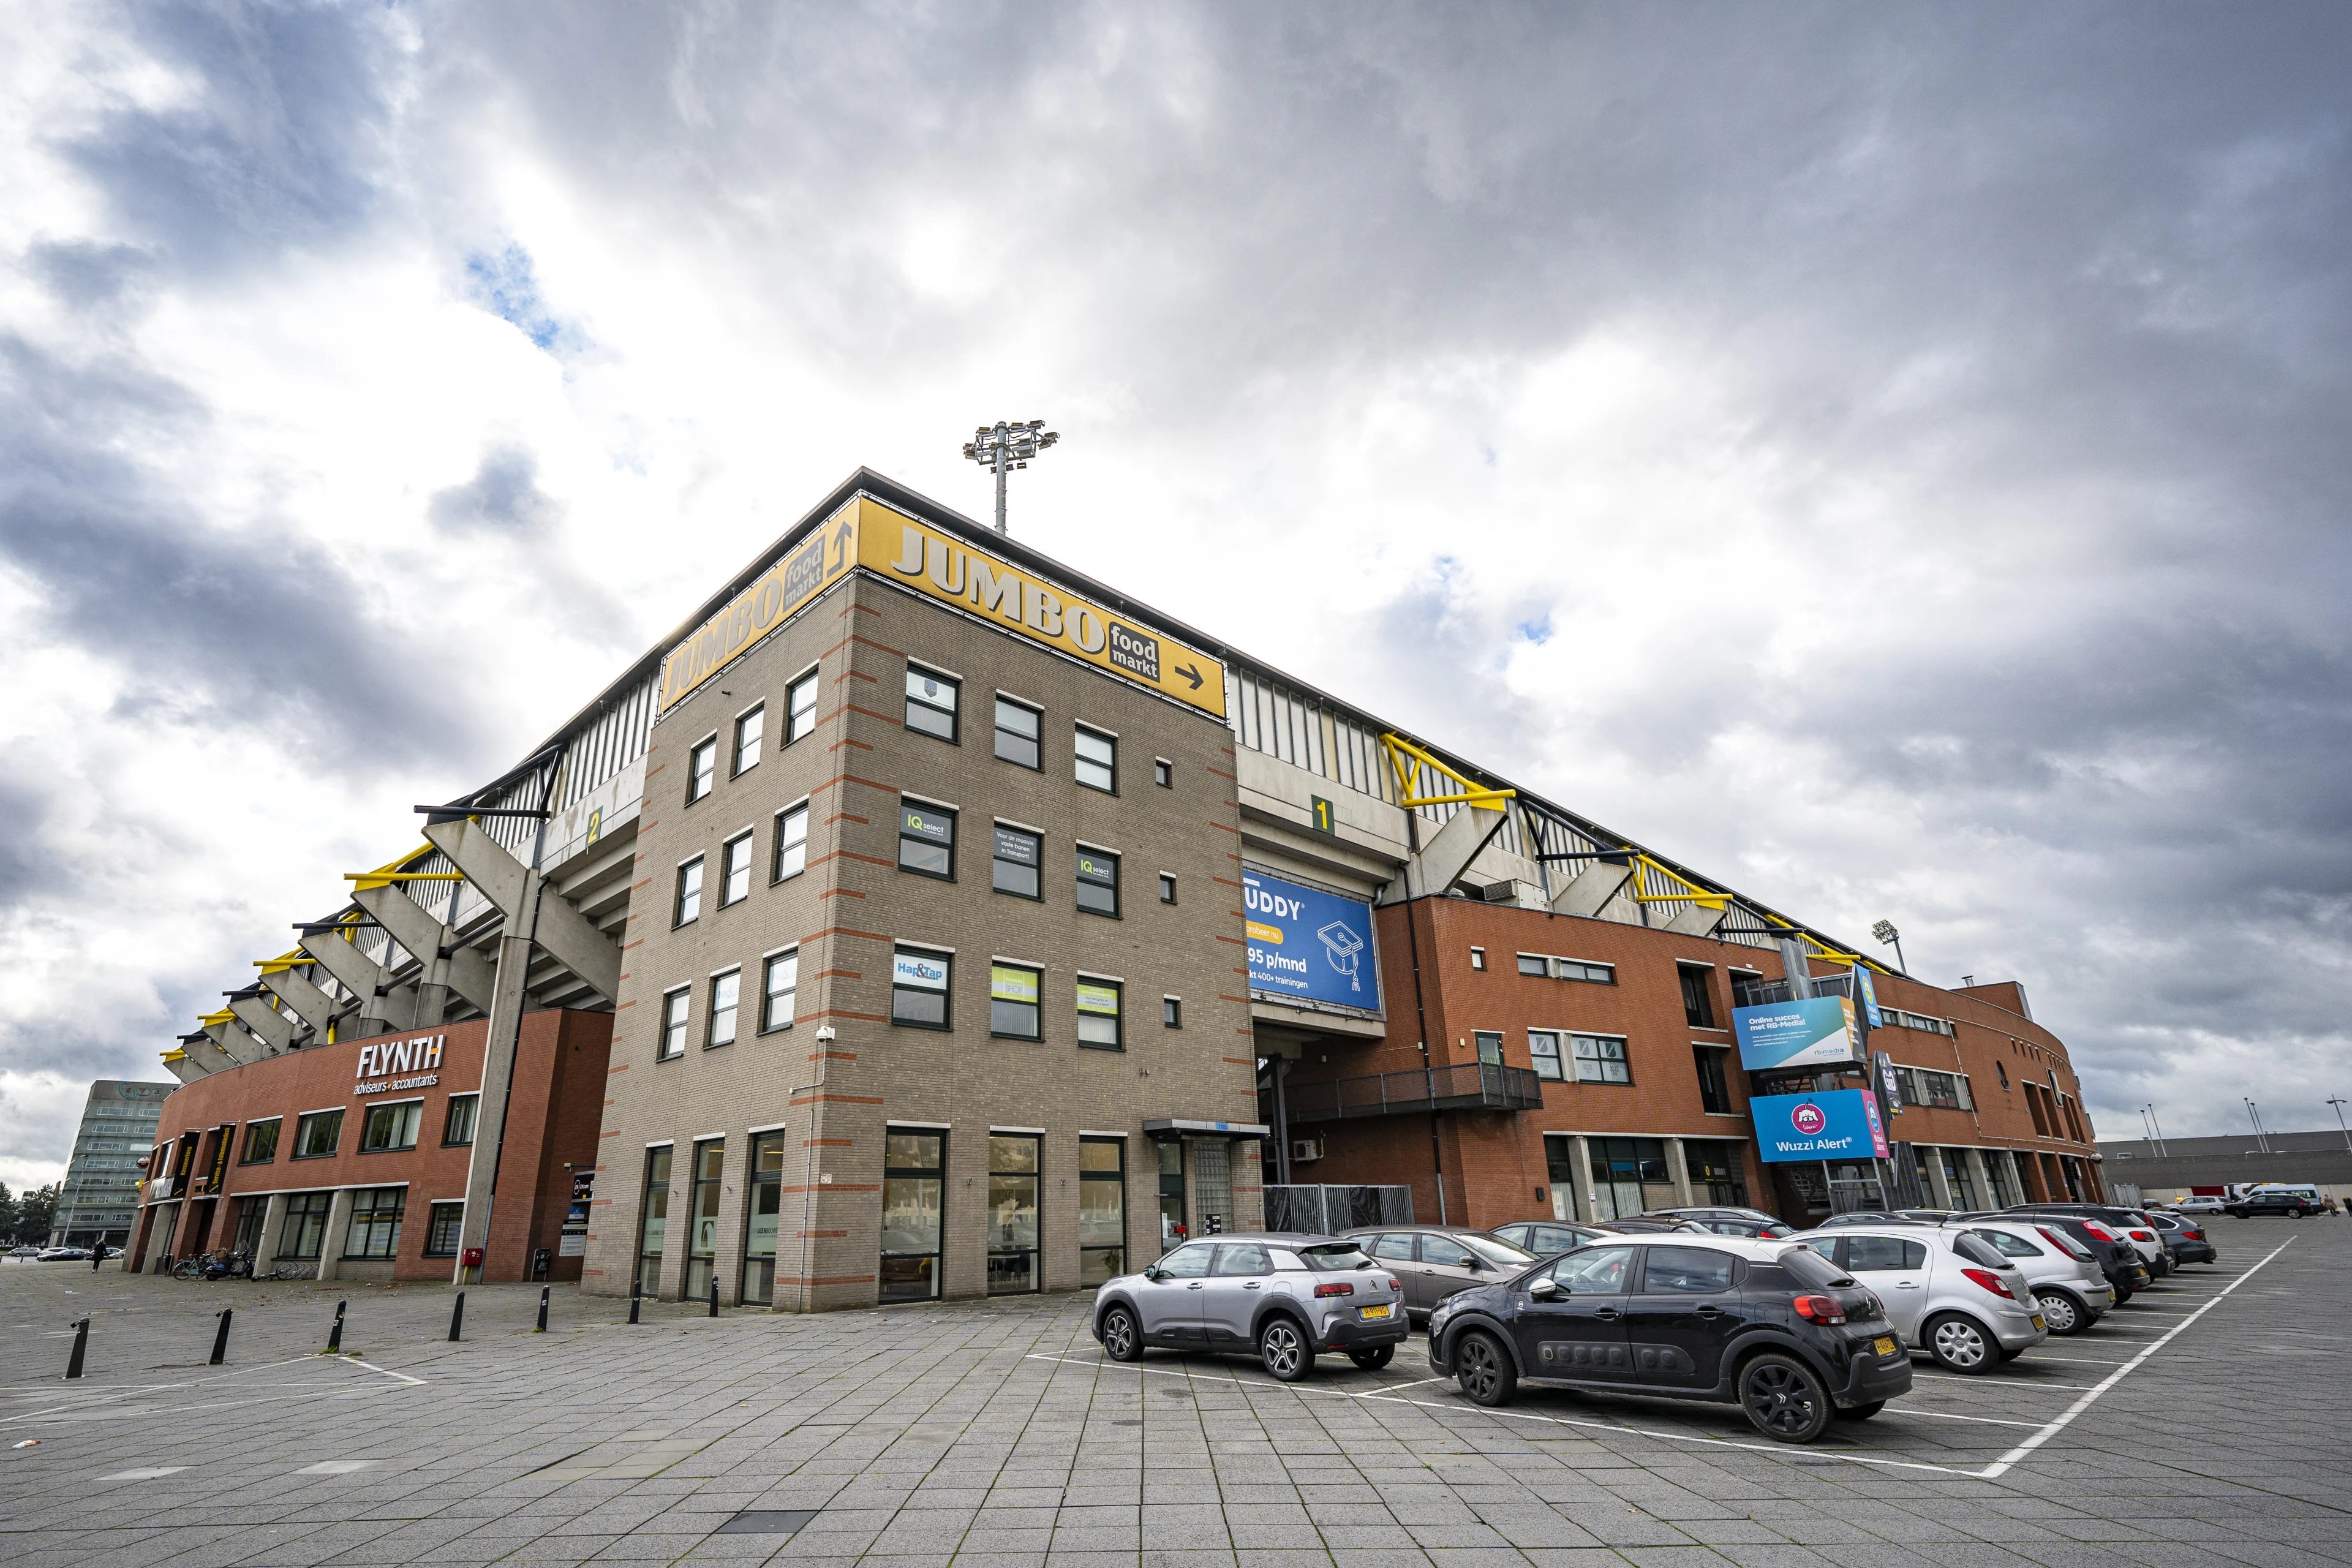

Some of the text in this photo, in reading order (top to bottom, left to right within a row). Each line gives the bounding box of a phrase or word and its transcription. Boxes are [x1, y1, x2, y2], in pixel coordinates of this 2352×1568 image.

[786, 540, 823, 589] food
[785, 567, 821, 606] markt
[891, 526, 1106, 655] JUMBO
[664, 578, 782, 704] JUMBO
[1111, 626, 1158, 663] food
[1112, 648, 1158, 679] markt
[908, 814, 944, 833] IQ select
[1317, 801, 1328, 829] 1
[588, 812, 600, 844] 2
[1007, 849, 1029, 859] Transport!
[1080, 859, 1093, 874] IQ
[1093, 867, 1109, 875] select
[897, 962, 943, 981] Hap&Tap
[1266, 952, 1306, 973] p/mnd
[1005, 984, 1023, 993] SHOP
[1258, 972, 1274, 981] 400+
[1275, 976, 1308, 989] trainingen
[1766, 1019, 1806, 1030] RB-Media!
[356, 1035, 445, 1078] FLYNTH
[354, 1074, 438, 1095] adviseurs accountants
[1776, 1140, 1814, 1152] Wuzzi
[1874, 1134, 1883, 1143] Mobiel
[1877, 1142, 1885, 1151] alarm
